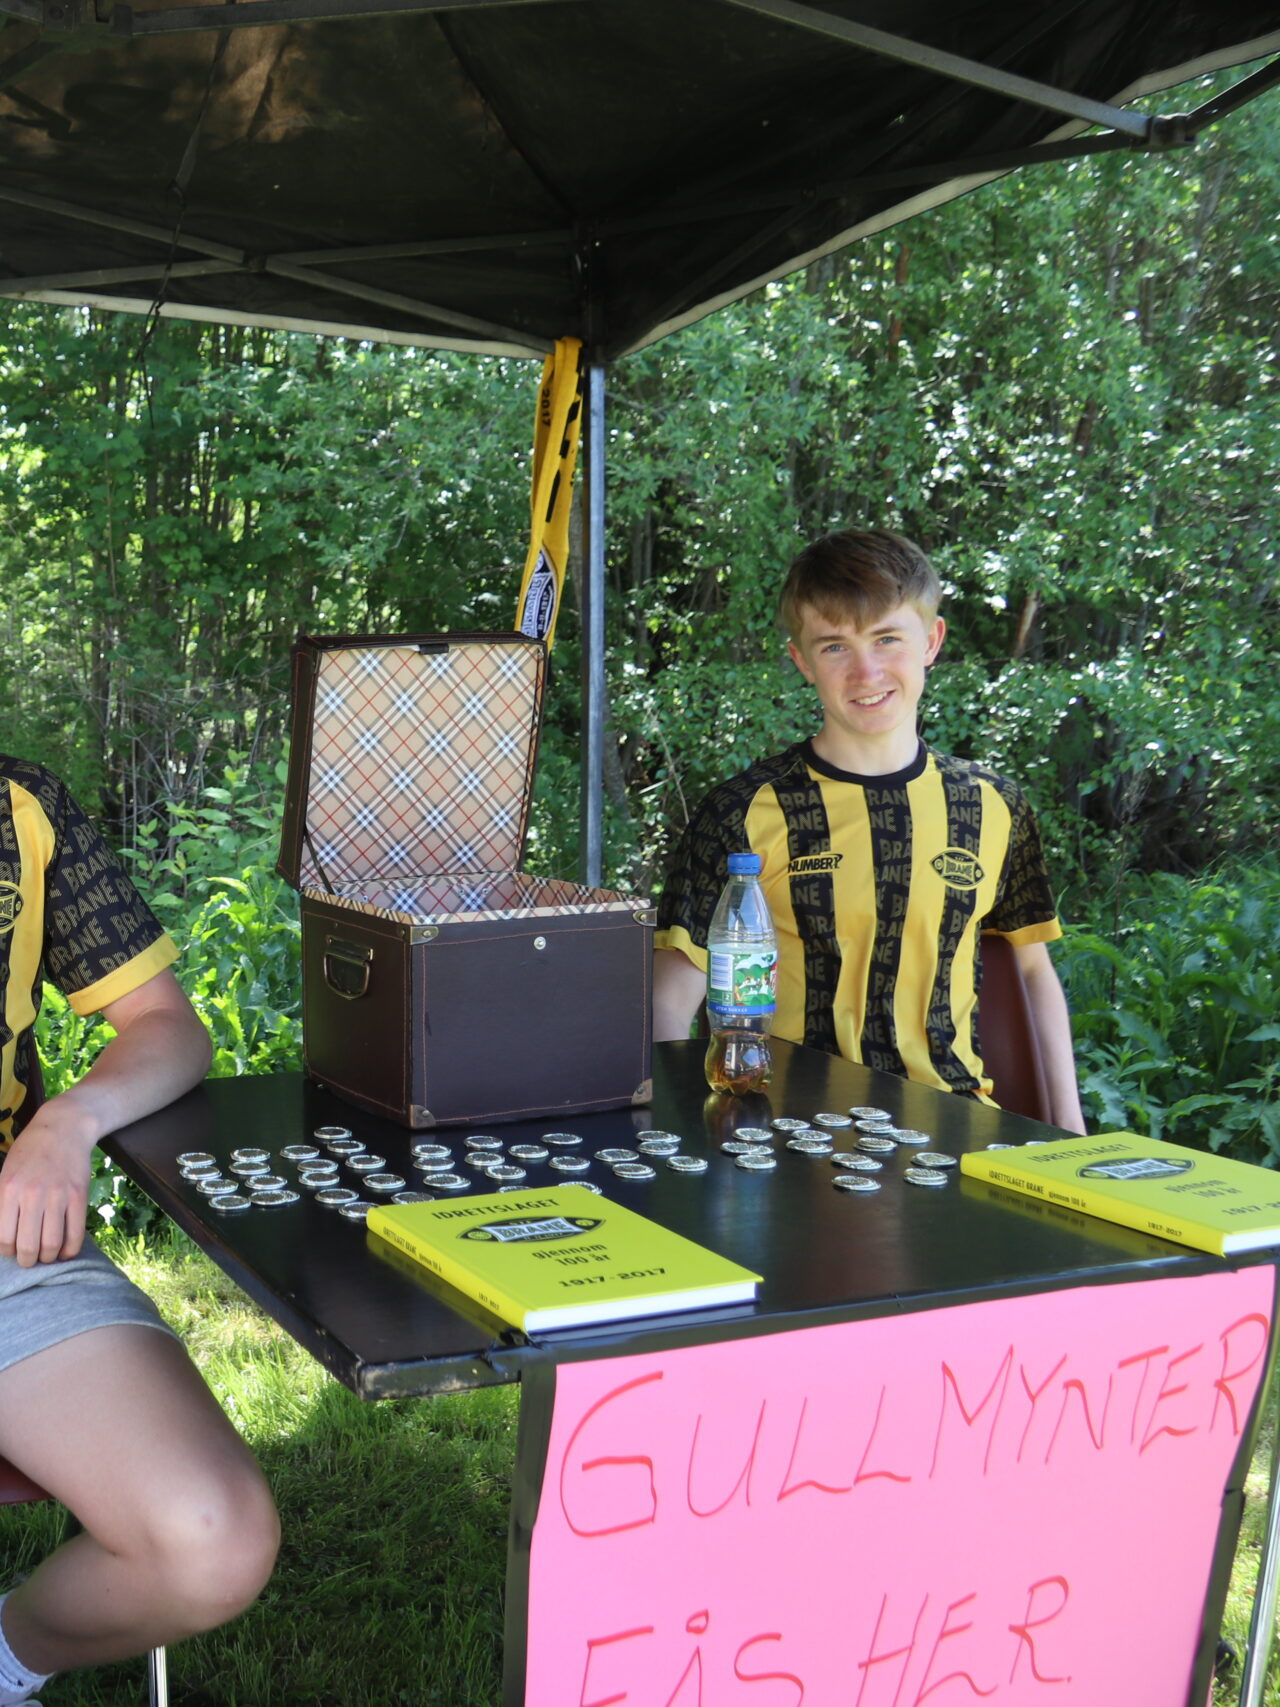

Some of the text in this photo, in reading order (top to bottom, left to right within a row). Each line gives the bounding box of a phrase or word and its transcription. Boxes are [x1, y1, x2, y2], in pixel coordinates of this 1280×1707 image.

[53, 874, 115, 938] BRANE
[1027, 1143, 1132, 1164] IDRETTSLAGET
[988, 1168, 1026, 1190] IDRETTSLAGET
[1025, 1179, 1044, 1195] BRANE
[431, 1198, 561, 1221] IDRETTSLAGET
[494, 1218, 569, 1240] BRANE
[531, 1243, 608, 1261] gjennom
[555, 1252, 612, 1266] 100 år
[559, 1312, 1270, 1538] GULLMYNTER
